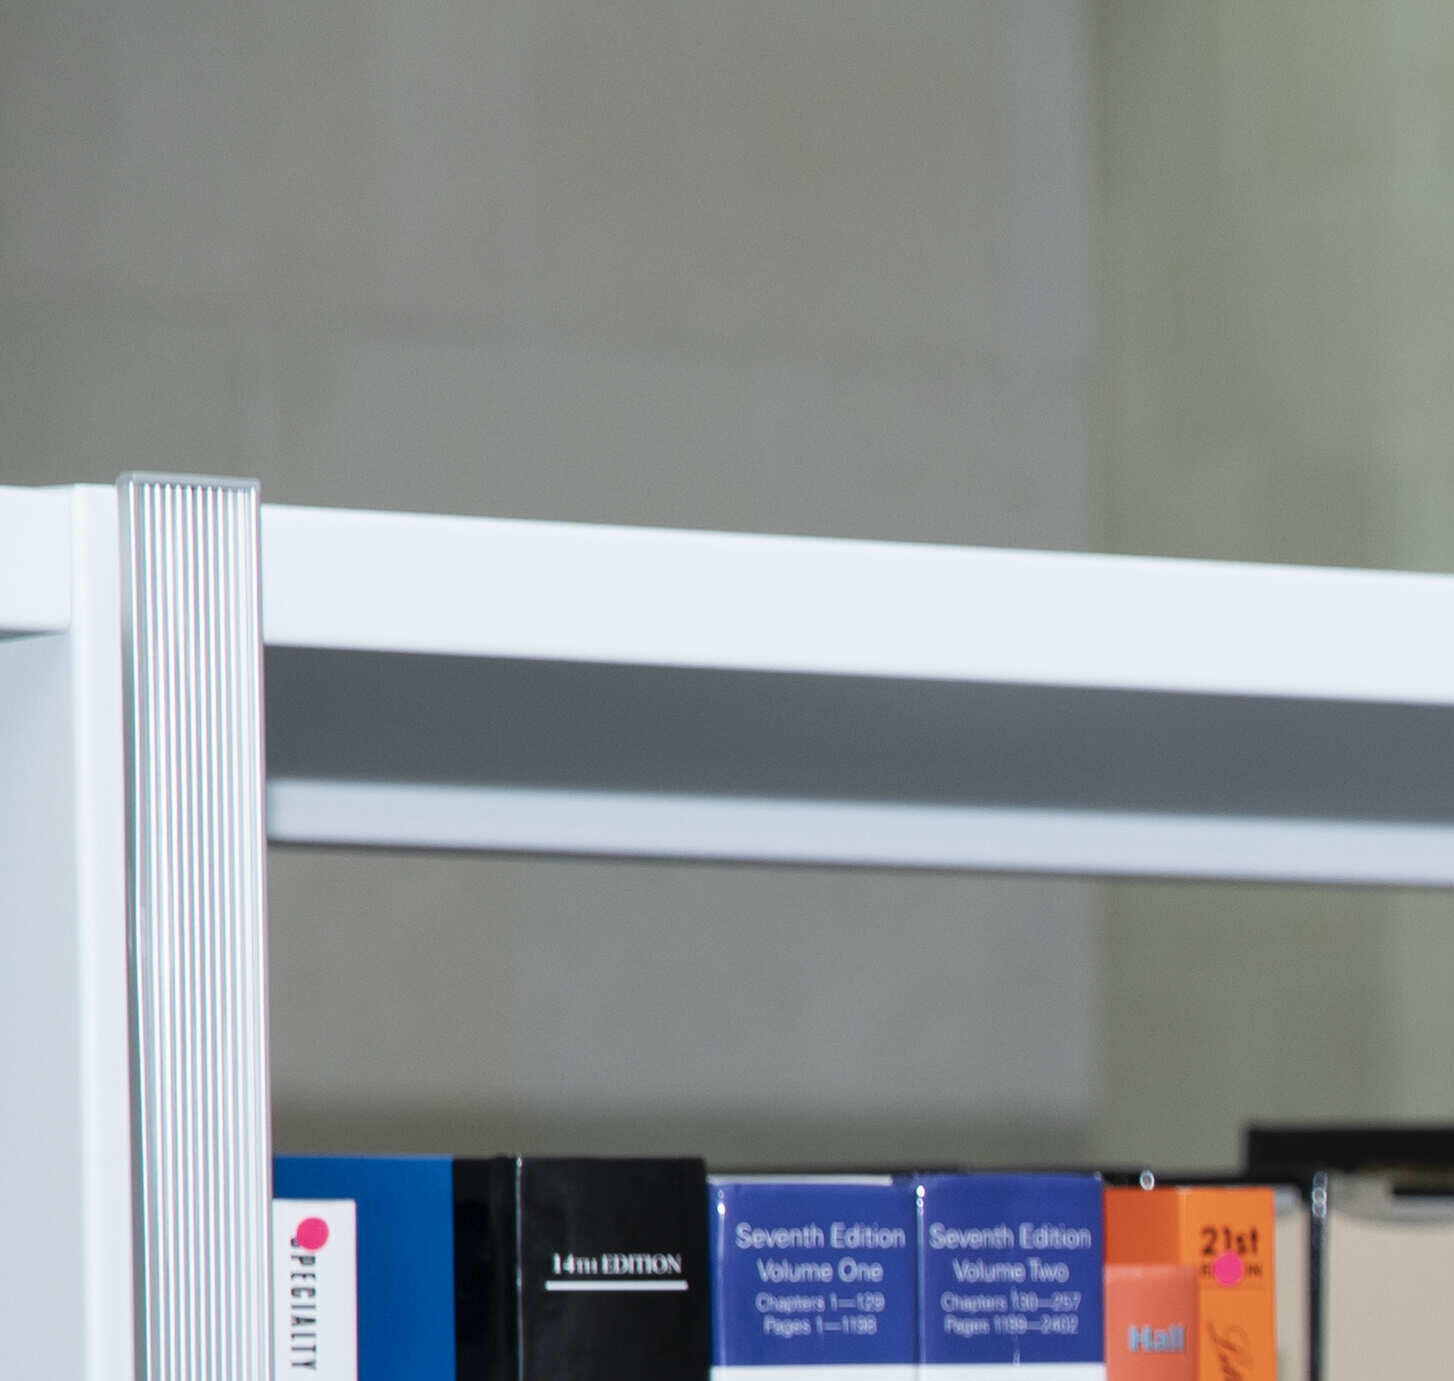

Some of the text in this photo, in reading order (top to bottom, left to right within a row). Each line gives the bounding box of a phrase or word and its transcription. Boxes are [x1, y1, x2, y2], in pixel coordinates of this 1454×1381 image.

[735, 1221, 906, 1249] Seventh Edition
[928, 1221, 1092, 1249] Seventh Edition
[1201, 1226, 1259, 1255] 21st
[601, 1253, 682, 1275] EDITION
[756, 1257, 884, 1283] Volume One
[952, 1256, 1070, 1283] Volume Two
[290, 1236, 318, 1370] PECIALTY
[755, 1291, 826, 1314] Chapters
[940, 1291, 1008, 1313] Chapters
[763, 1316, 811, 1338] Pages
[944, 1316, 991, 1338] Pages
[1129, 1325, 1186, 1353] Hall
